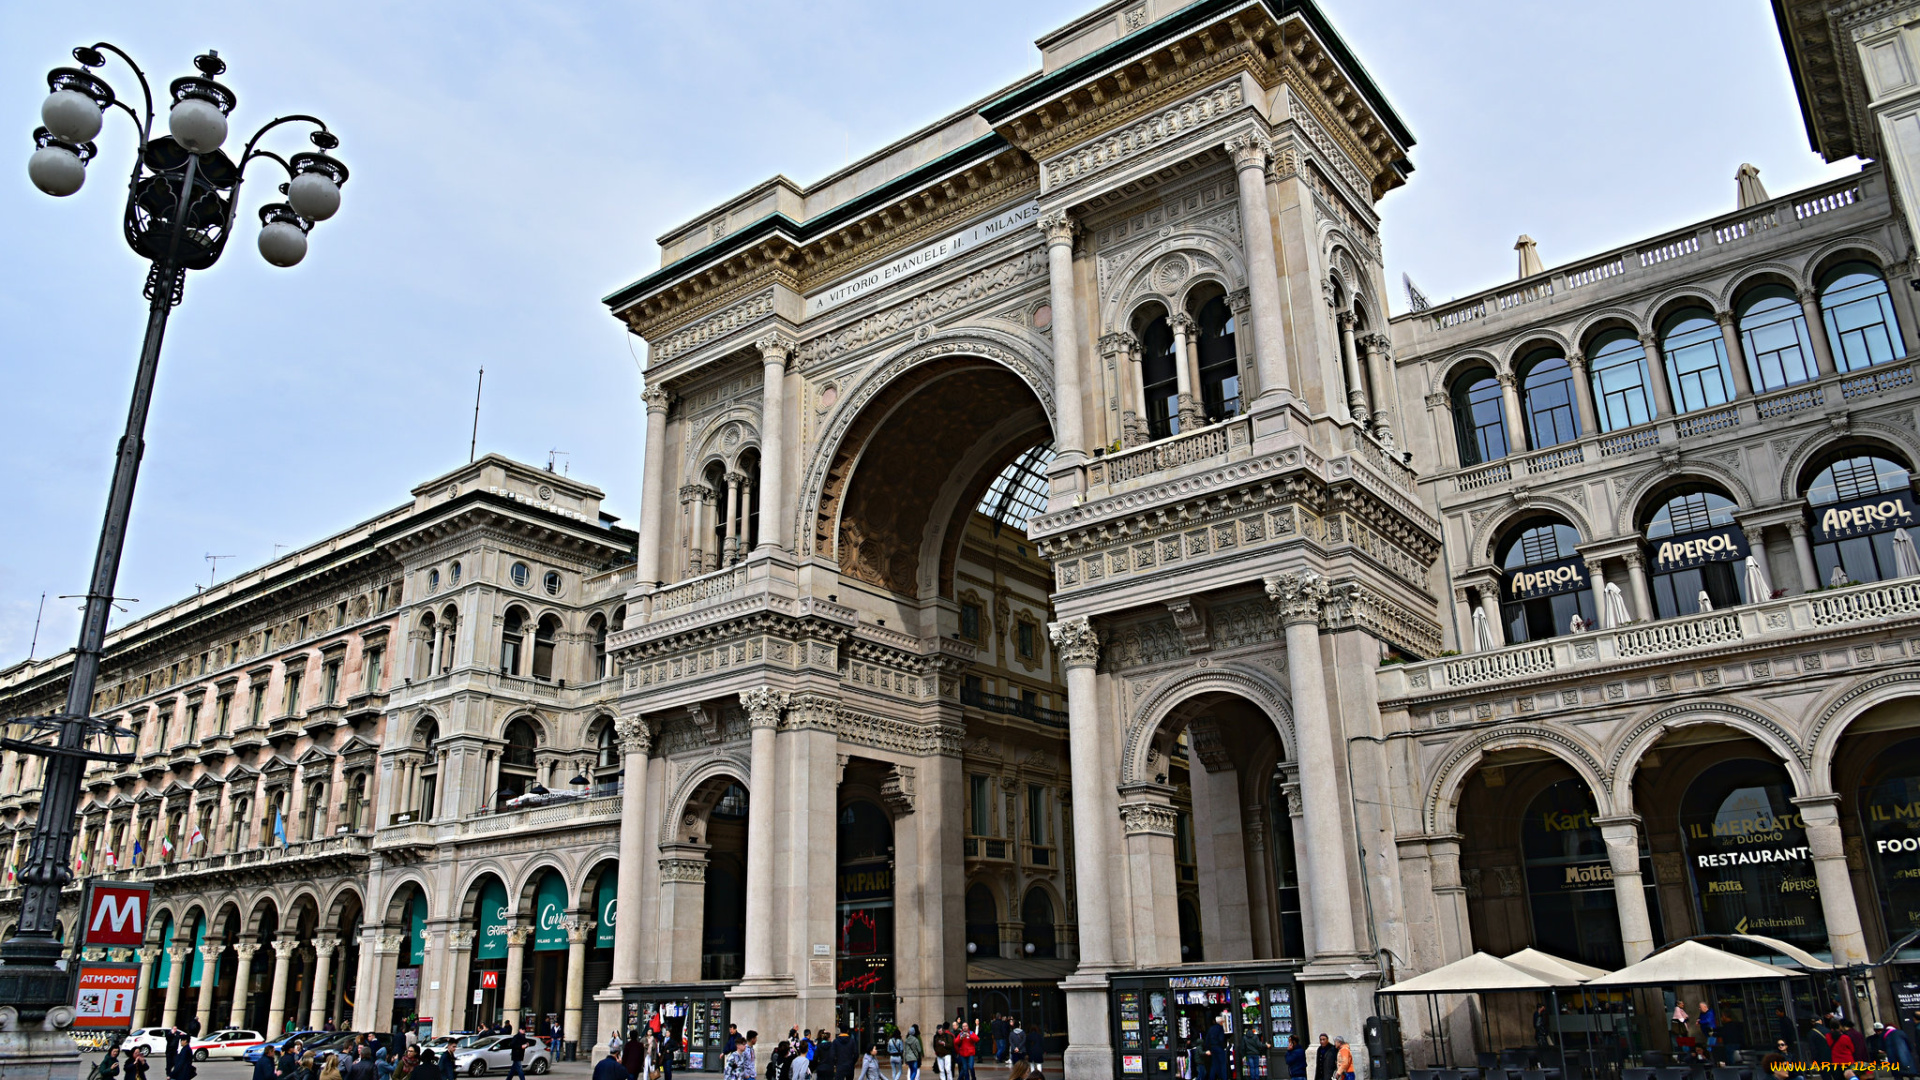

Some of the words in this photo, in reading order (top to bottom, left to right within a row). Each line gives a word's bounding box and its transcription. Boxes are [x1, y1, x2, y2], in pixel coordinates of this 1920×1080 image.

[816, 299, 824, 308] A
[829, 274, 879, 301] VITTORIO
[884, 244, 947, 279] EMANUELE
[1822, 498, 1912, 532] APEROL
[1824, 516, 1914, 539] TERRAZZA
[1658, 533, 1738, 564] APEROL
[1659, 550, 1740, 571] TERRAZZA
[1511, 564, 1583, 593] APEROL
[1512, 580, 1585, 600] TERRAZZA
[1870, 804, 1891, 821] IL
[1690, 823, 1708, 839] IL
[1711, 812, 1806, 837] MERCATO
[1736, 832, 1784, 845] DUOMO
[1877, 837, 1920, 854] FOO
[1565, 864, 1613, 884] Motta
[1709, 879, 1744, 893] Motta
[91, 894, 142, 934] M
[81, 974, 103, 984] ATM
[104, 975, 137, 984] POINT
[483, 974, 497, 985] M
